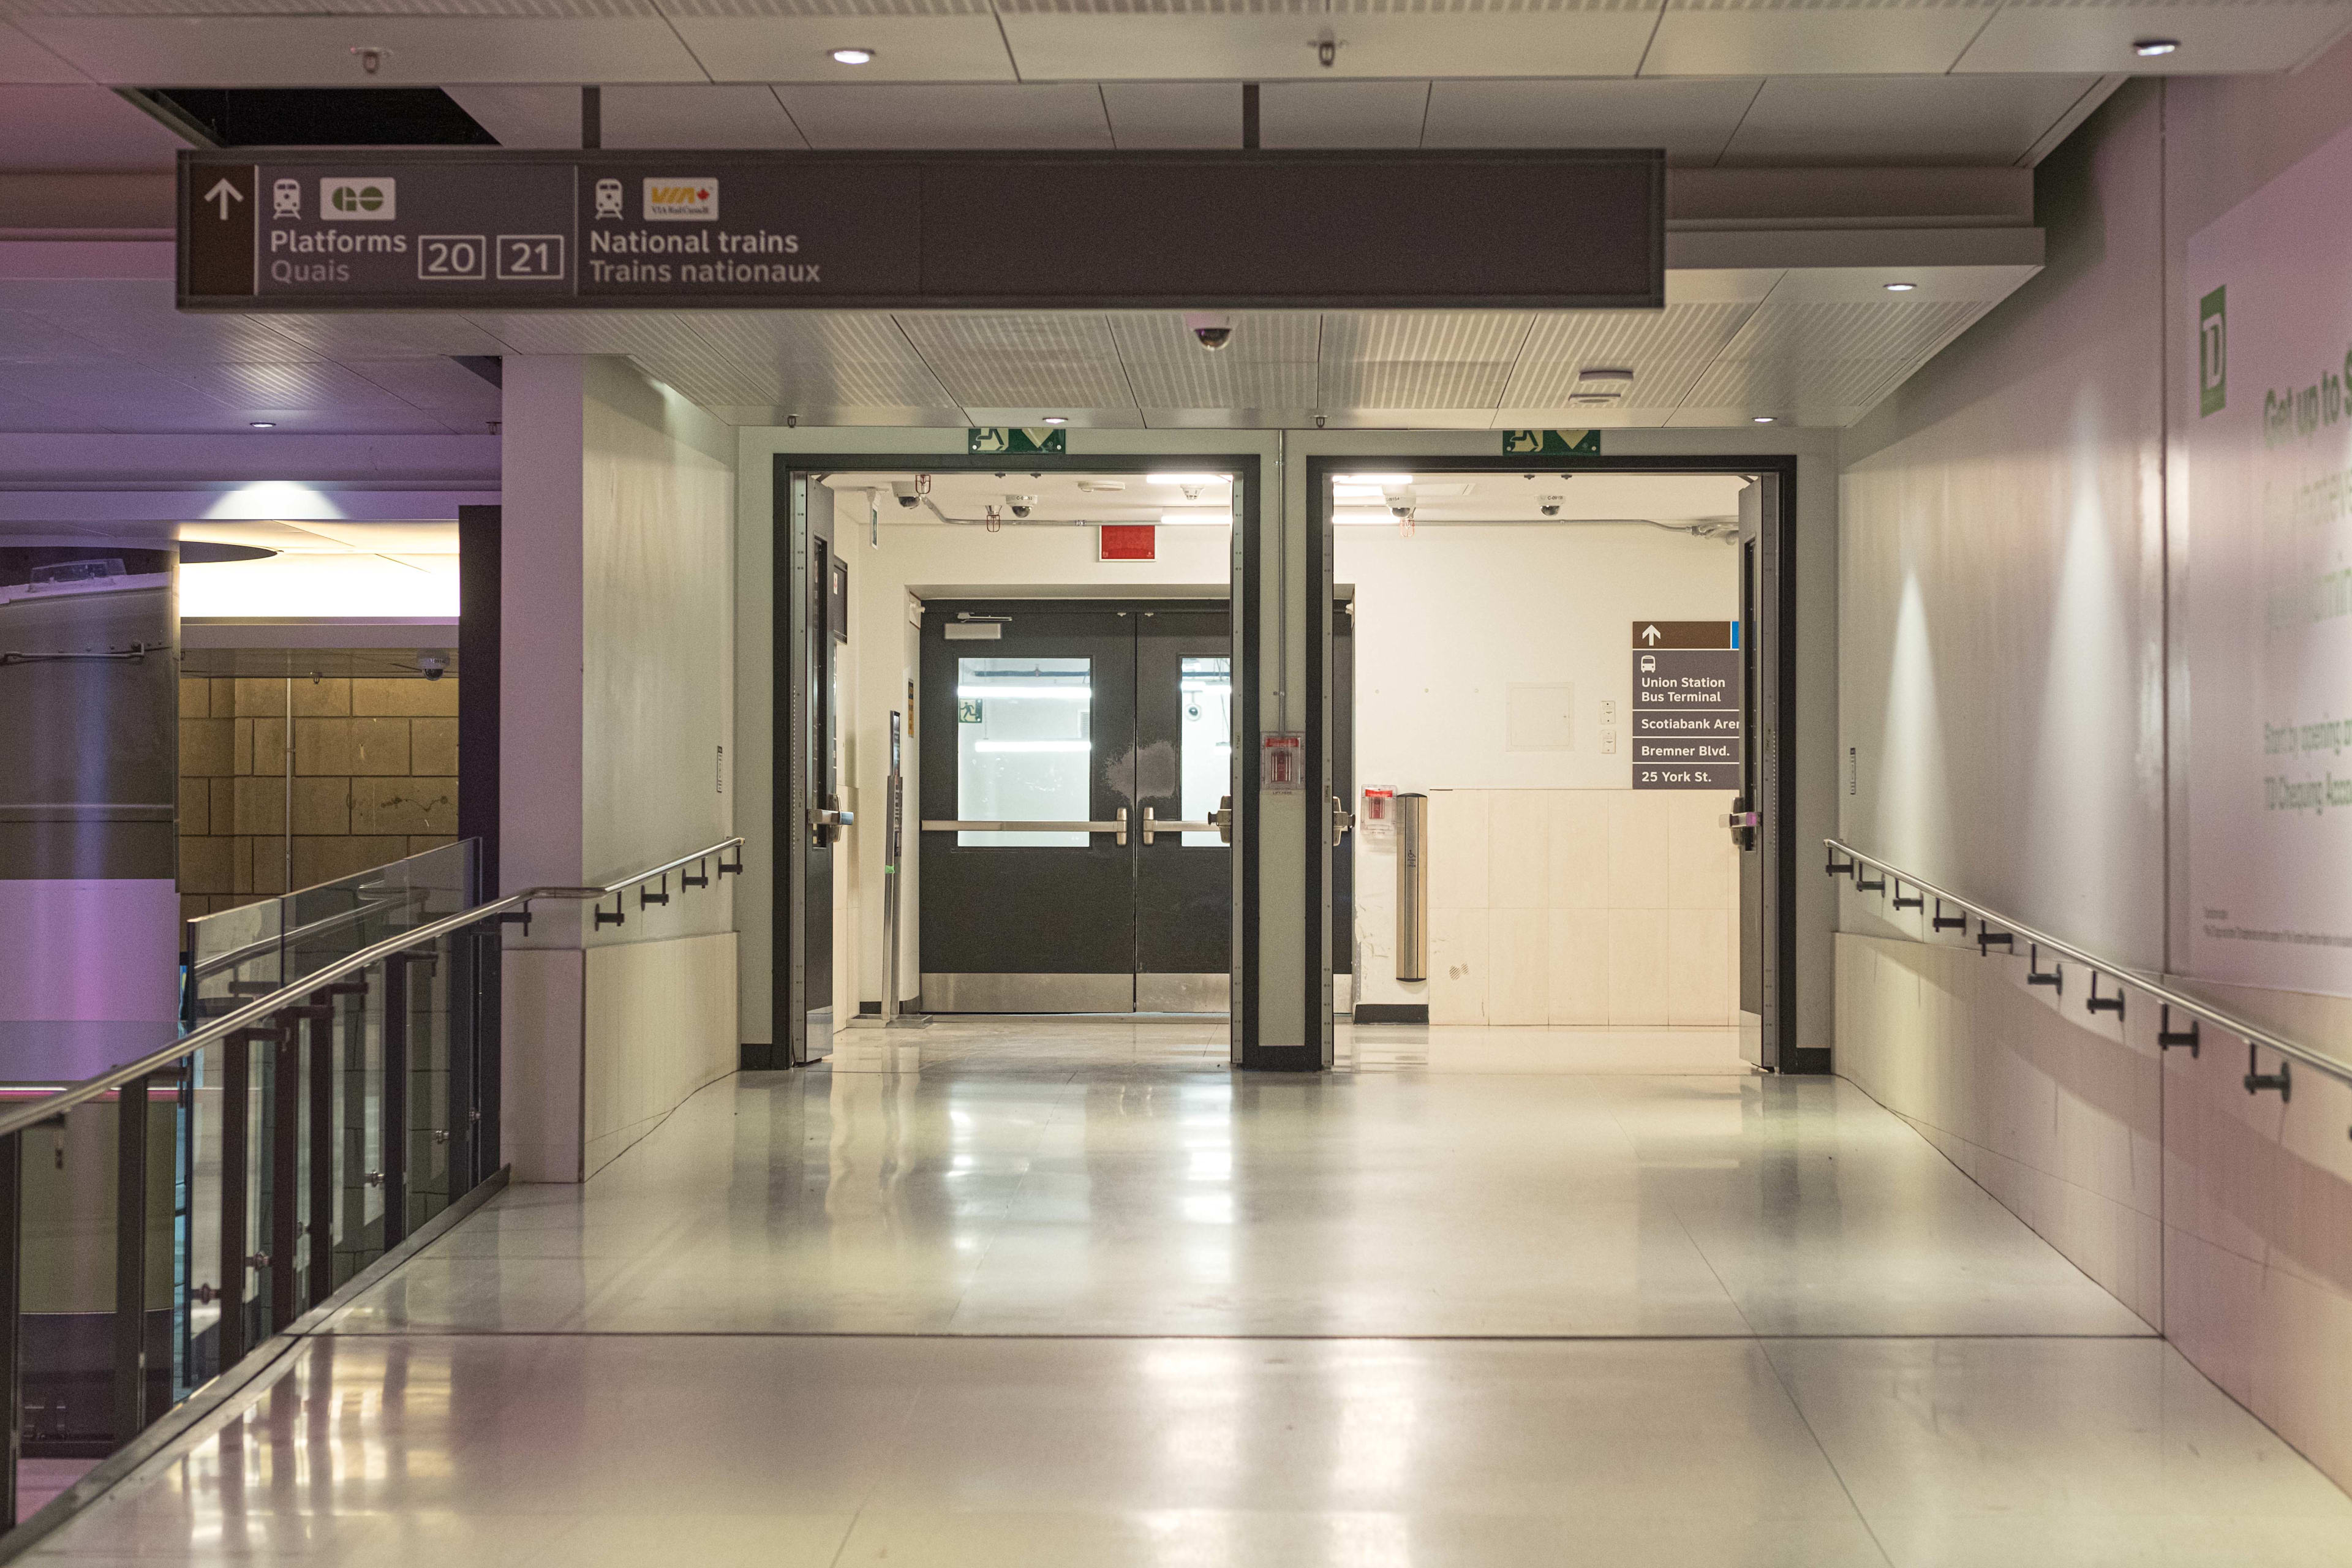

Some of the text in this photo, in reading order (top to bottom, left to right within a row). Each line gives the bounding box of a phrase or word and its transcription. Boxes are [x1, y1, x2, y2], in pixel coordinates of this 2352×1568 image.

[652, 187, 695, 203] VIA
[271, 230, 407, 253] Platforms
[590, 230, 799, 253] National trains
[429, 243, 475, 273] 20
[511, 243, 548, 273] 21
[271, 260, 350, 284] Quais
[590, 260, 821, 282] Trains nationaux
[1642, 677, 1725, 688] Union Station
[1642, 692, 1721, 702] Bus Terminal
[1642, 718, 1710, 729] Scotiabank
[1642, 745, 1730, 756] Bremner Blvd.
[1642, 772, 1711, 782] 25 York St.
